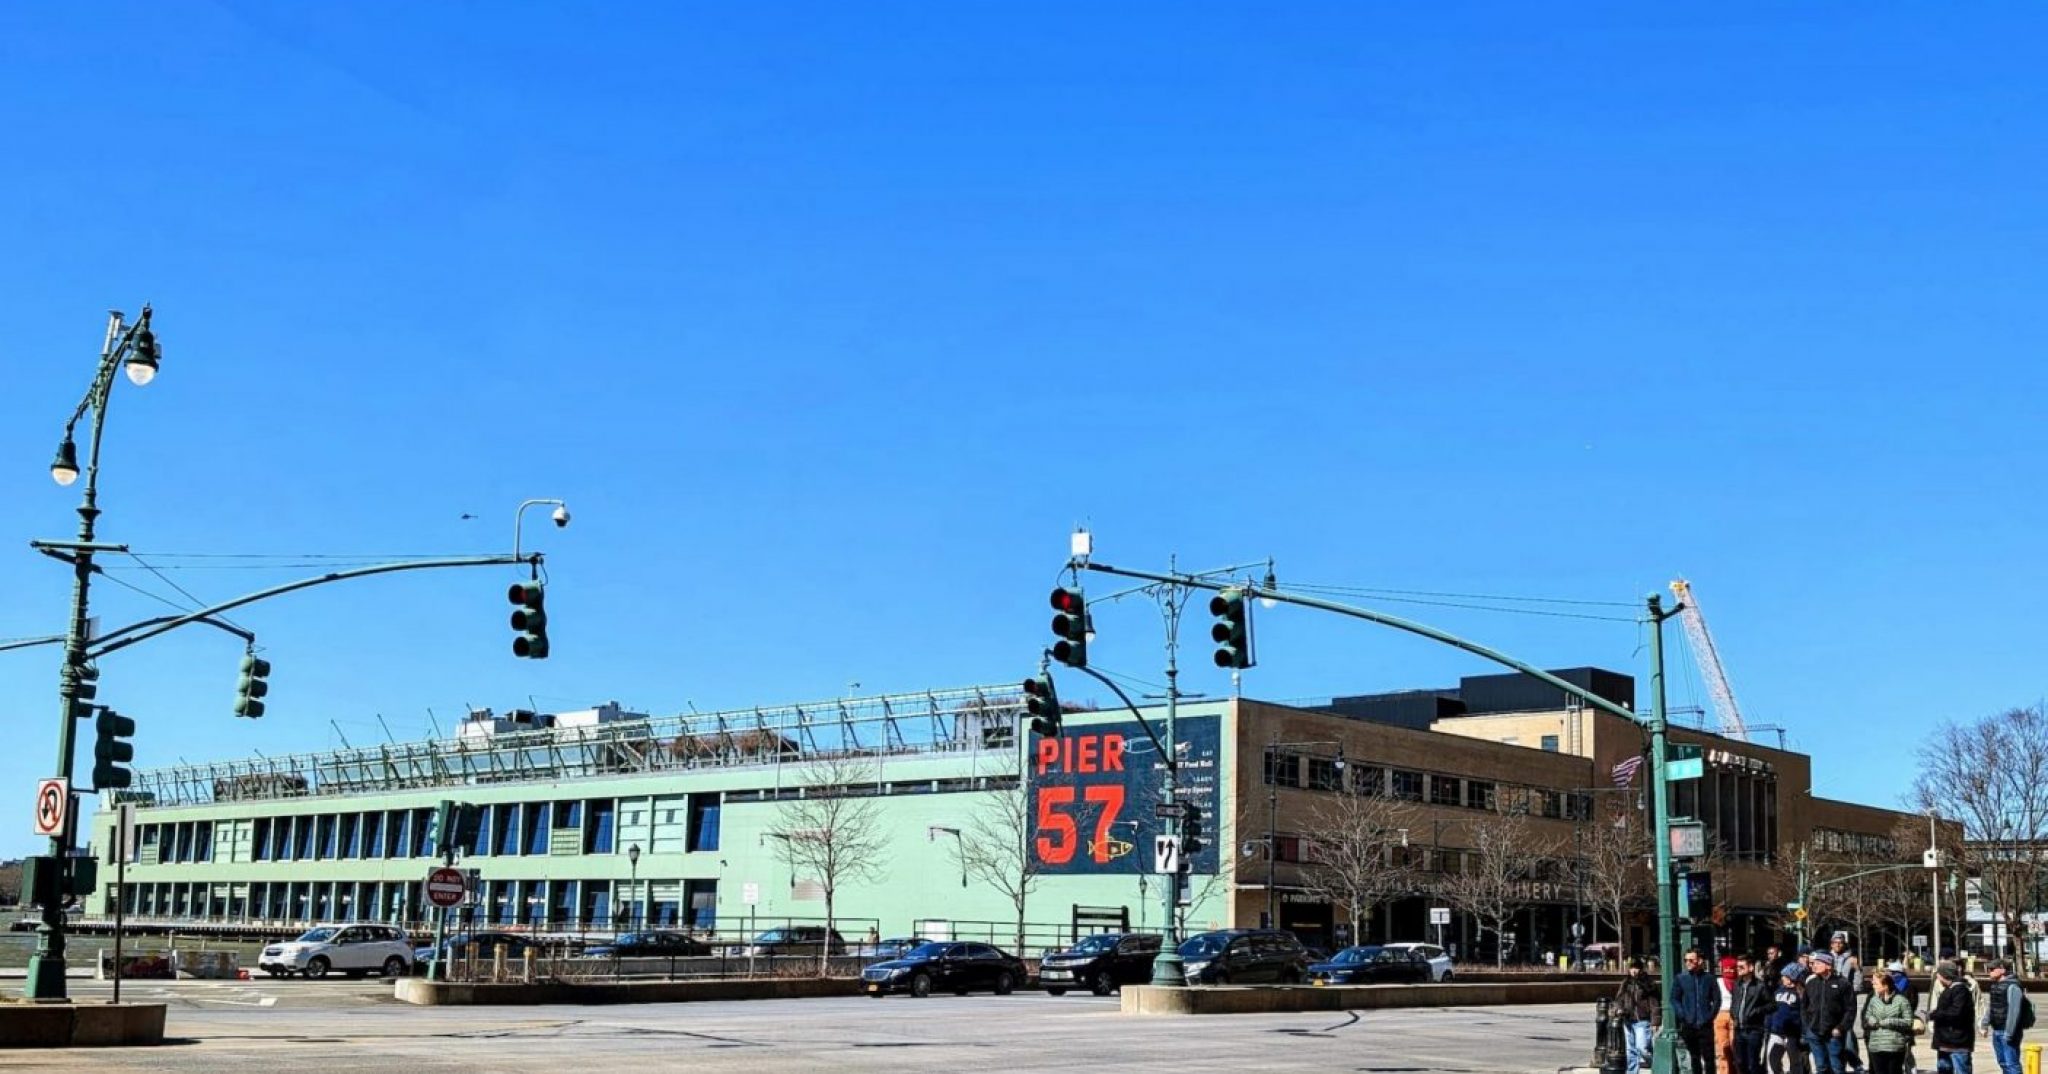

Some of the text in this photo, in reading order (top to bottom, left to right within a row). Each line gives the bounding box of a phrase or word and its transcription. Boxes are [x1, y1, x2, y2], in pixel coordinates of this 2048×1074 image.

[1038, 734, 1125, 775] PIER
[1037, 786, 1125, 864] 57
[433, 873, 460, 883] DO NOT
[433, 892, 457, 900] ENTER
